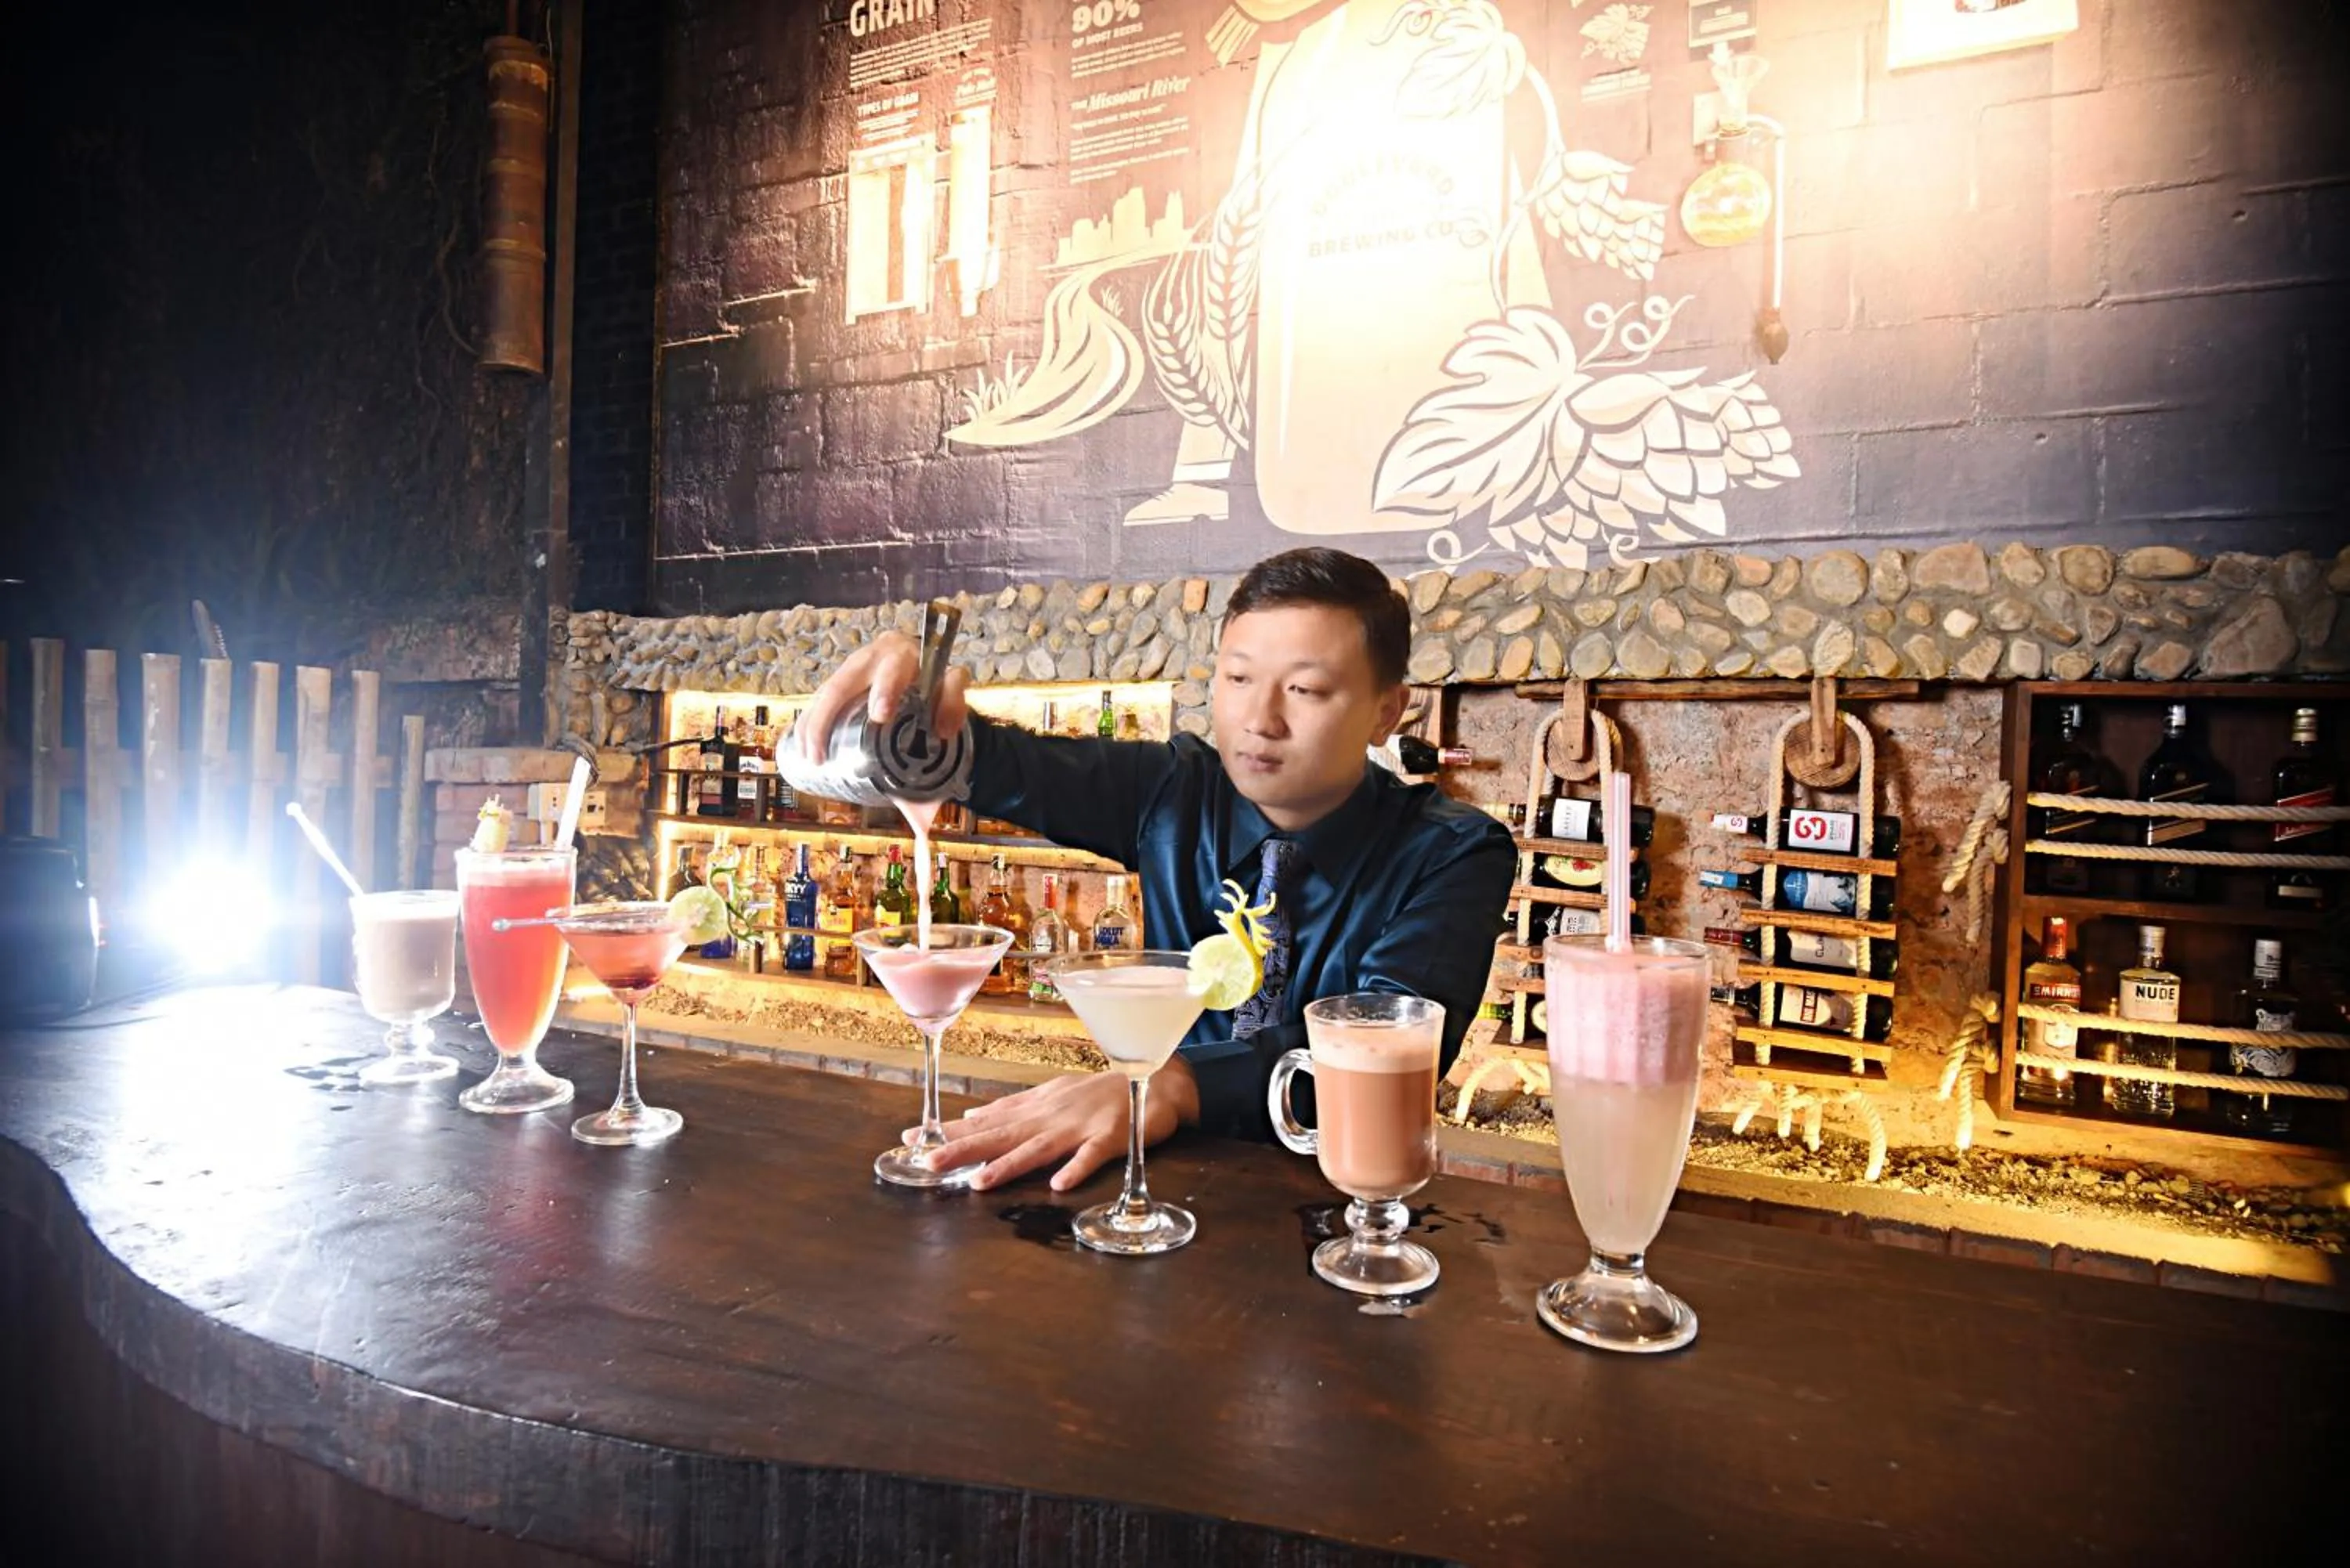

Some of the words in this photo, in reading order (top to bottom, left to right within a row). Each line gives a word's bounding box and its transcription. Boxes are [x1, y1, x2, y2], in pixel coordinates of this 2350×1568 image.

[1072, 0, 1141, 33] 90%
[1086, 82, 1150, 114] Missouri
[1151, 77, 1191, 99] River
[1307, 227, 1416, 258] BREWING
[2136, 985, 2175, 1000] NUDE
